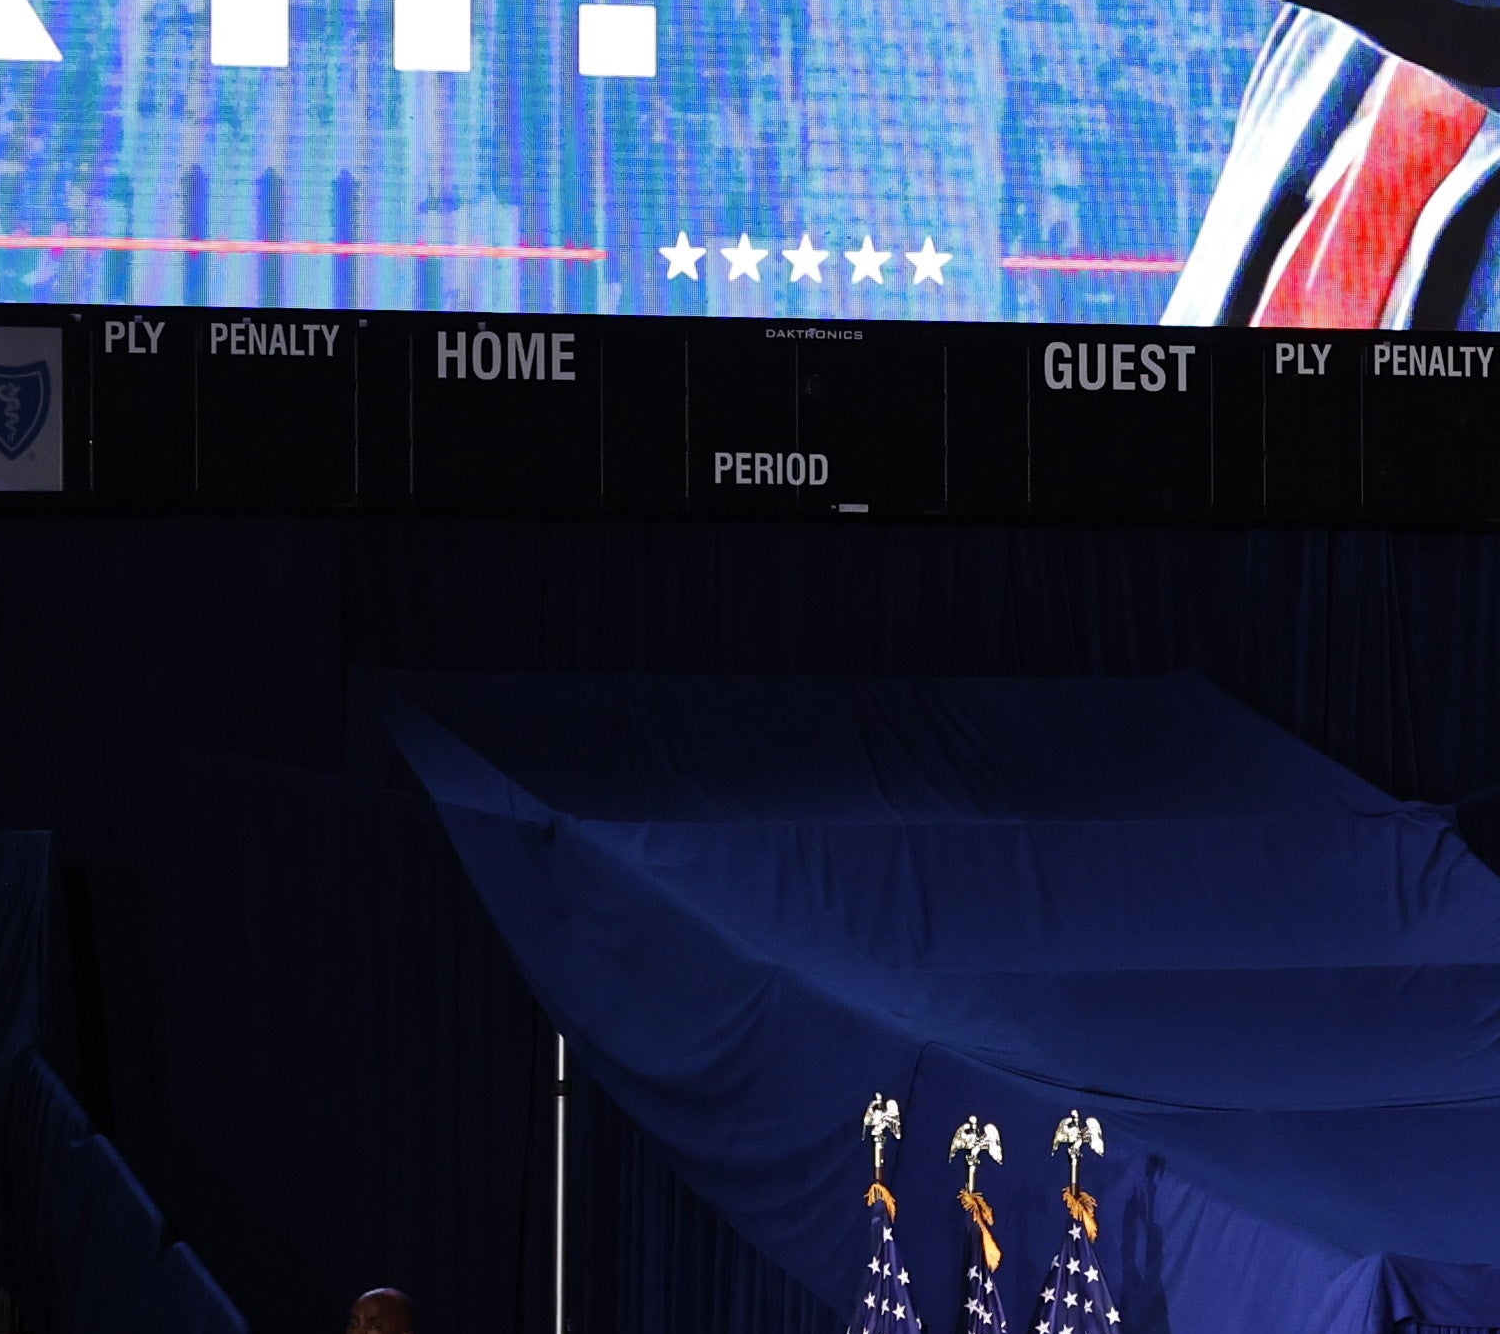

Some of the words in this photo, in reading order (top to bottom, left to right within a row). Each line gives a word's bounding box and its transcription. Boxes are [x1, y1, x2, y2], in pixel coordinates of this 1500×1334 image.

[103, 321, 165, 355] PLY
[209, 322, 339, 358] PENALTY
[764, 328, 864, 341] DAKTRONICS
[436, 330, 577, 382] HOME
[1043, 341, 1197, 392] GUEST
[1274, 341, 1333, 376] PLY
[1373, 344, 1496, 379] PENALTY
[713, 451, 830, 487] PERIOD
